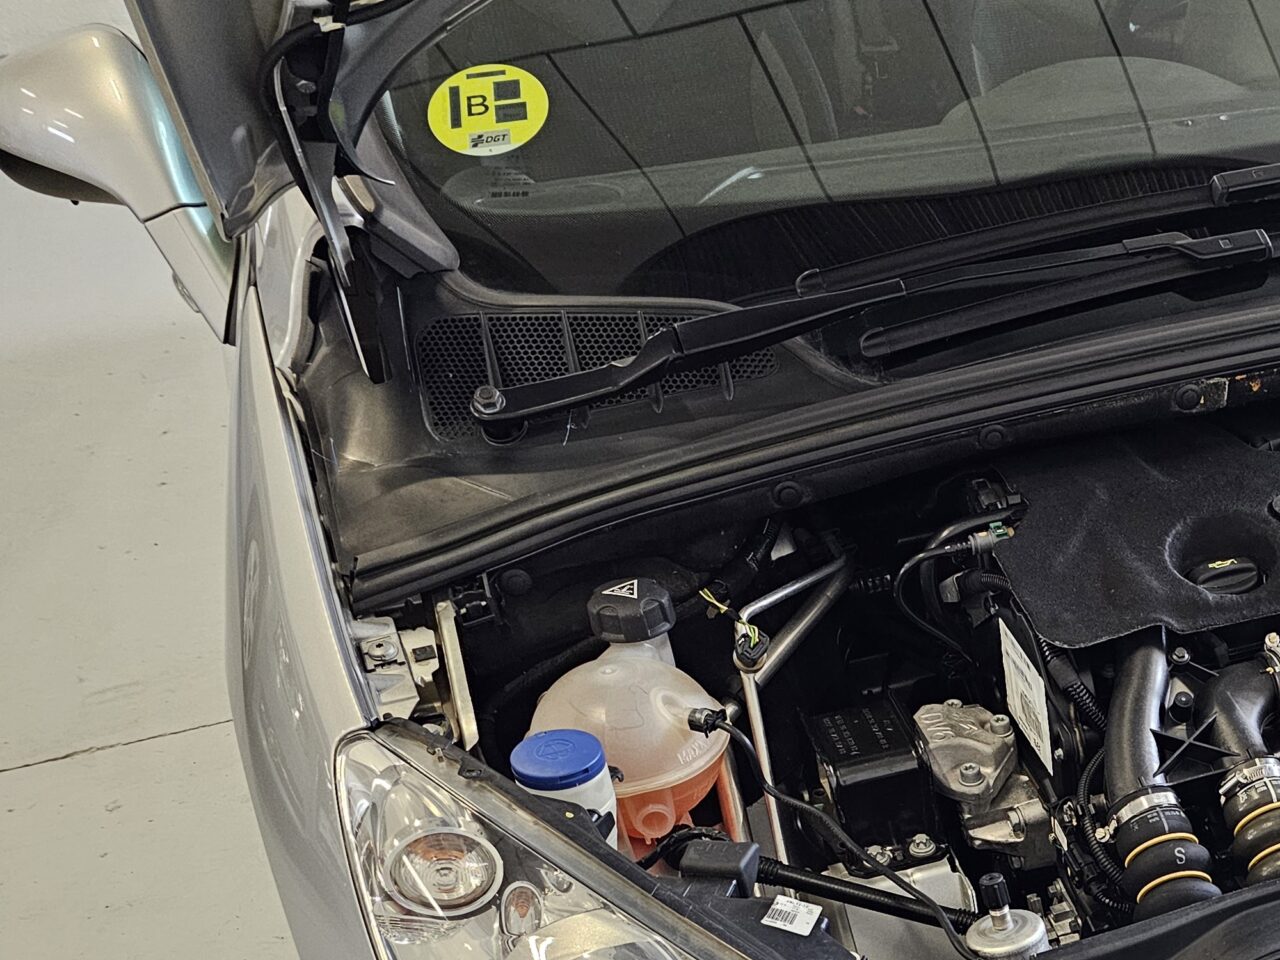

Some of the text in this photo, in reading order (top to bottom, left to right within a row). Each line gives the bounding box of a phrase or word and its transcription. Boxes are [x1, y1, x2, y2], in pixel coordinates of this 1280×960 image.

[466, 94, 490, 117] B
[485, 133, 509, 144] DGT
[1174, 846, 1187, 865] S
